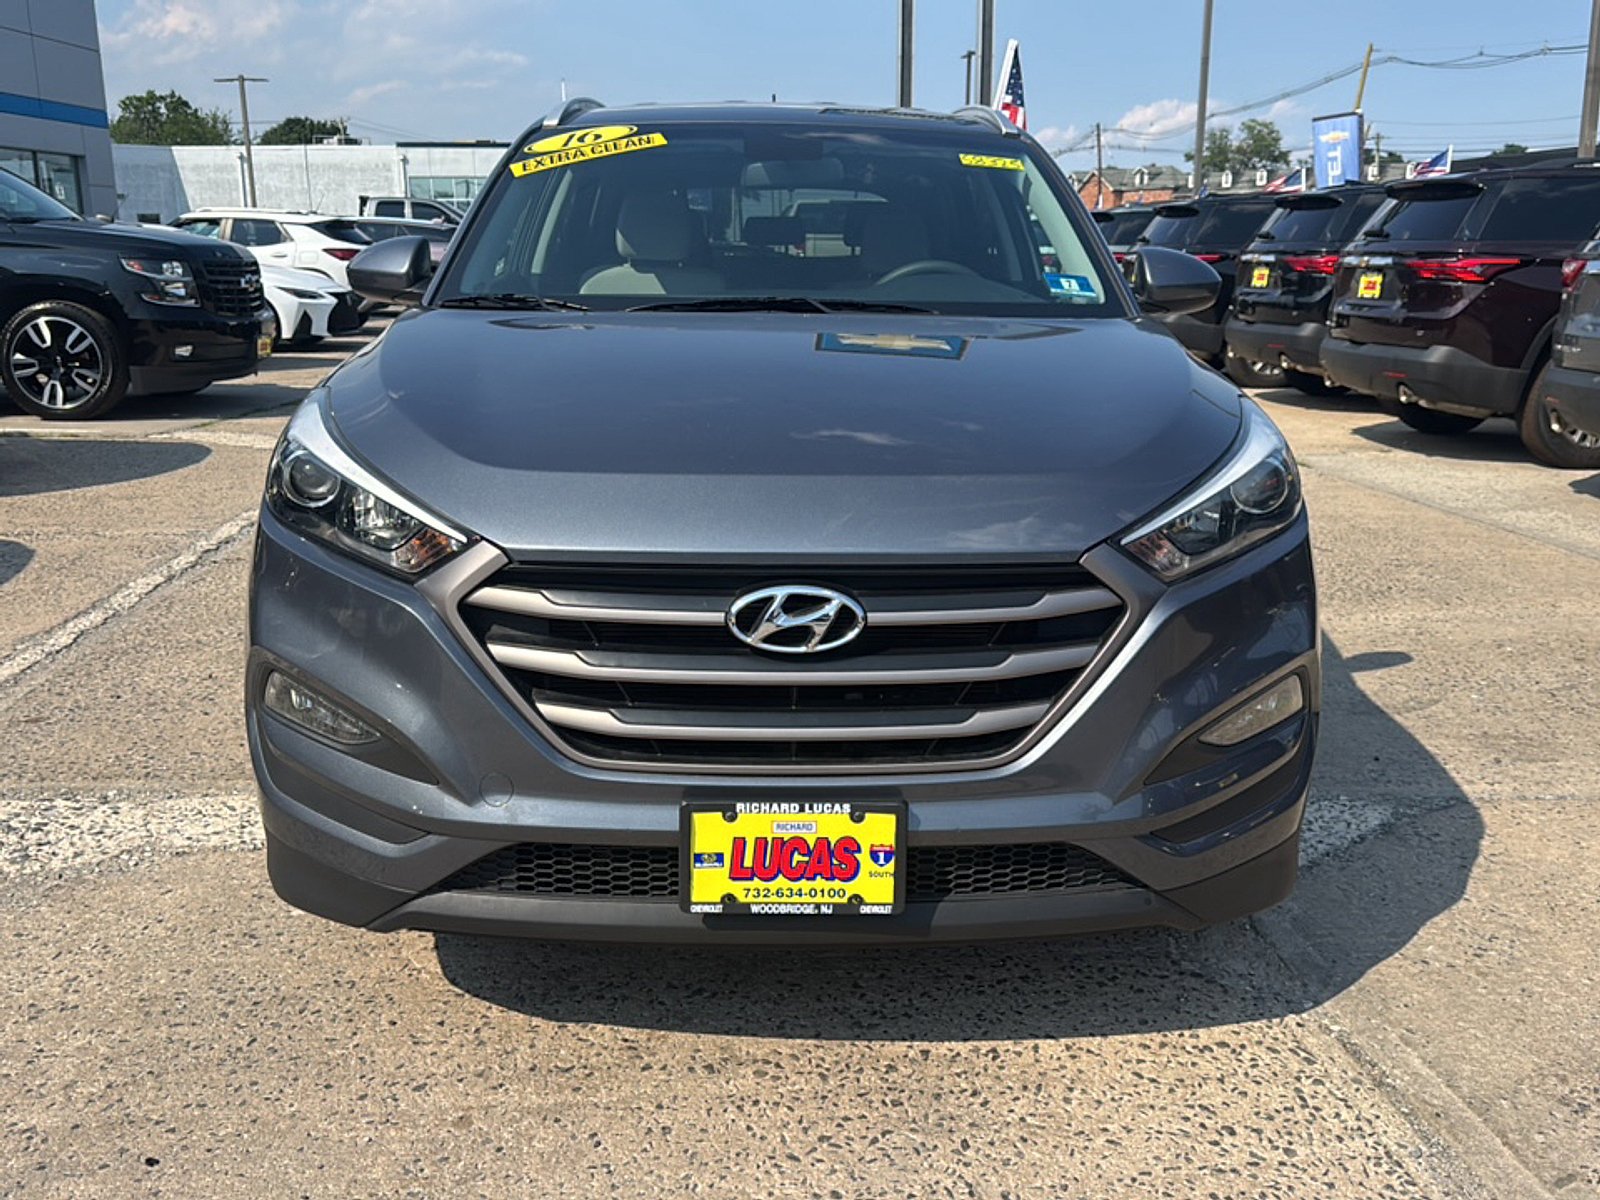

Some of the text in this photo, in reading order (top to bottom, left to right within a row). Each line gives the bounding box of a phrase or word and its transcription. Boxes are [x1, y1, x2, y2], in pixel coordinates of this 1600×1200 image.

[522, 136, 655, 171] EXTRA CLEAN
[736, 803, 851, 814] RICHARD LUCAS
[775, 823, 814, 832] RICHARD
[729, 836, 862, 882] LUCAS
[877, 851, 887, 865] 1
[743, 888, 847, 899] 732-634-0100
[820, 904, 833, 915] NJ
